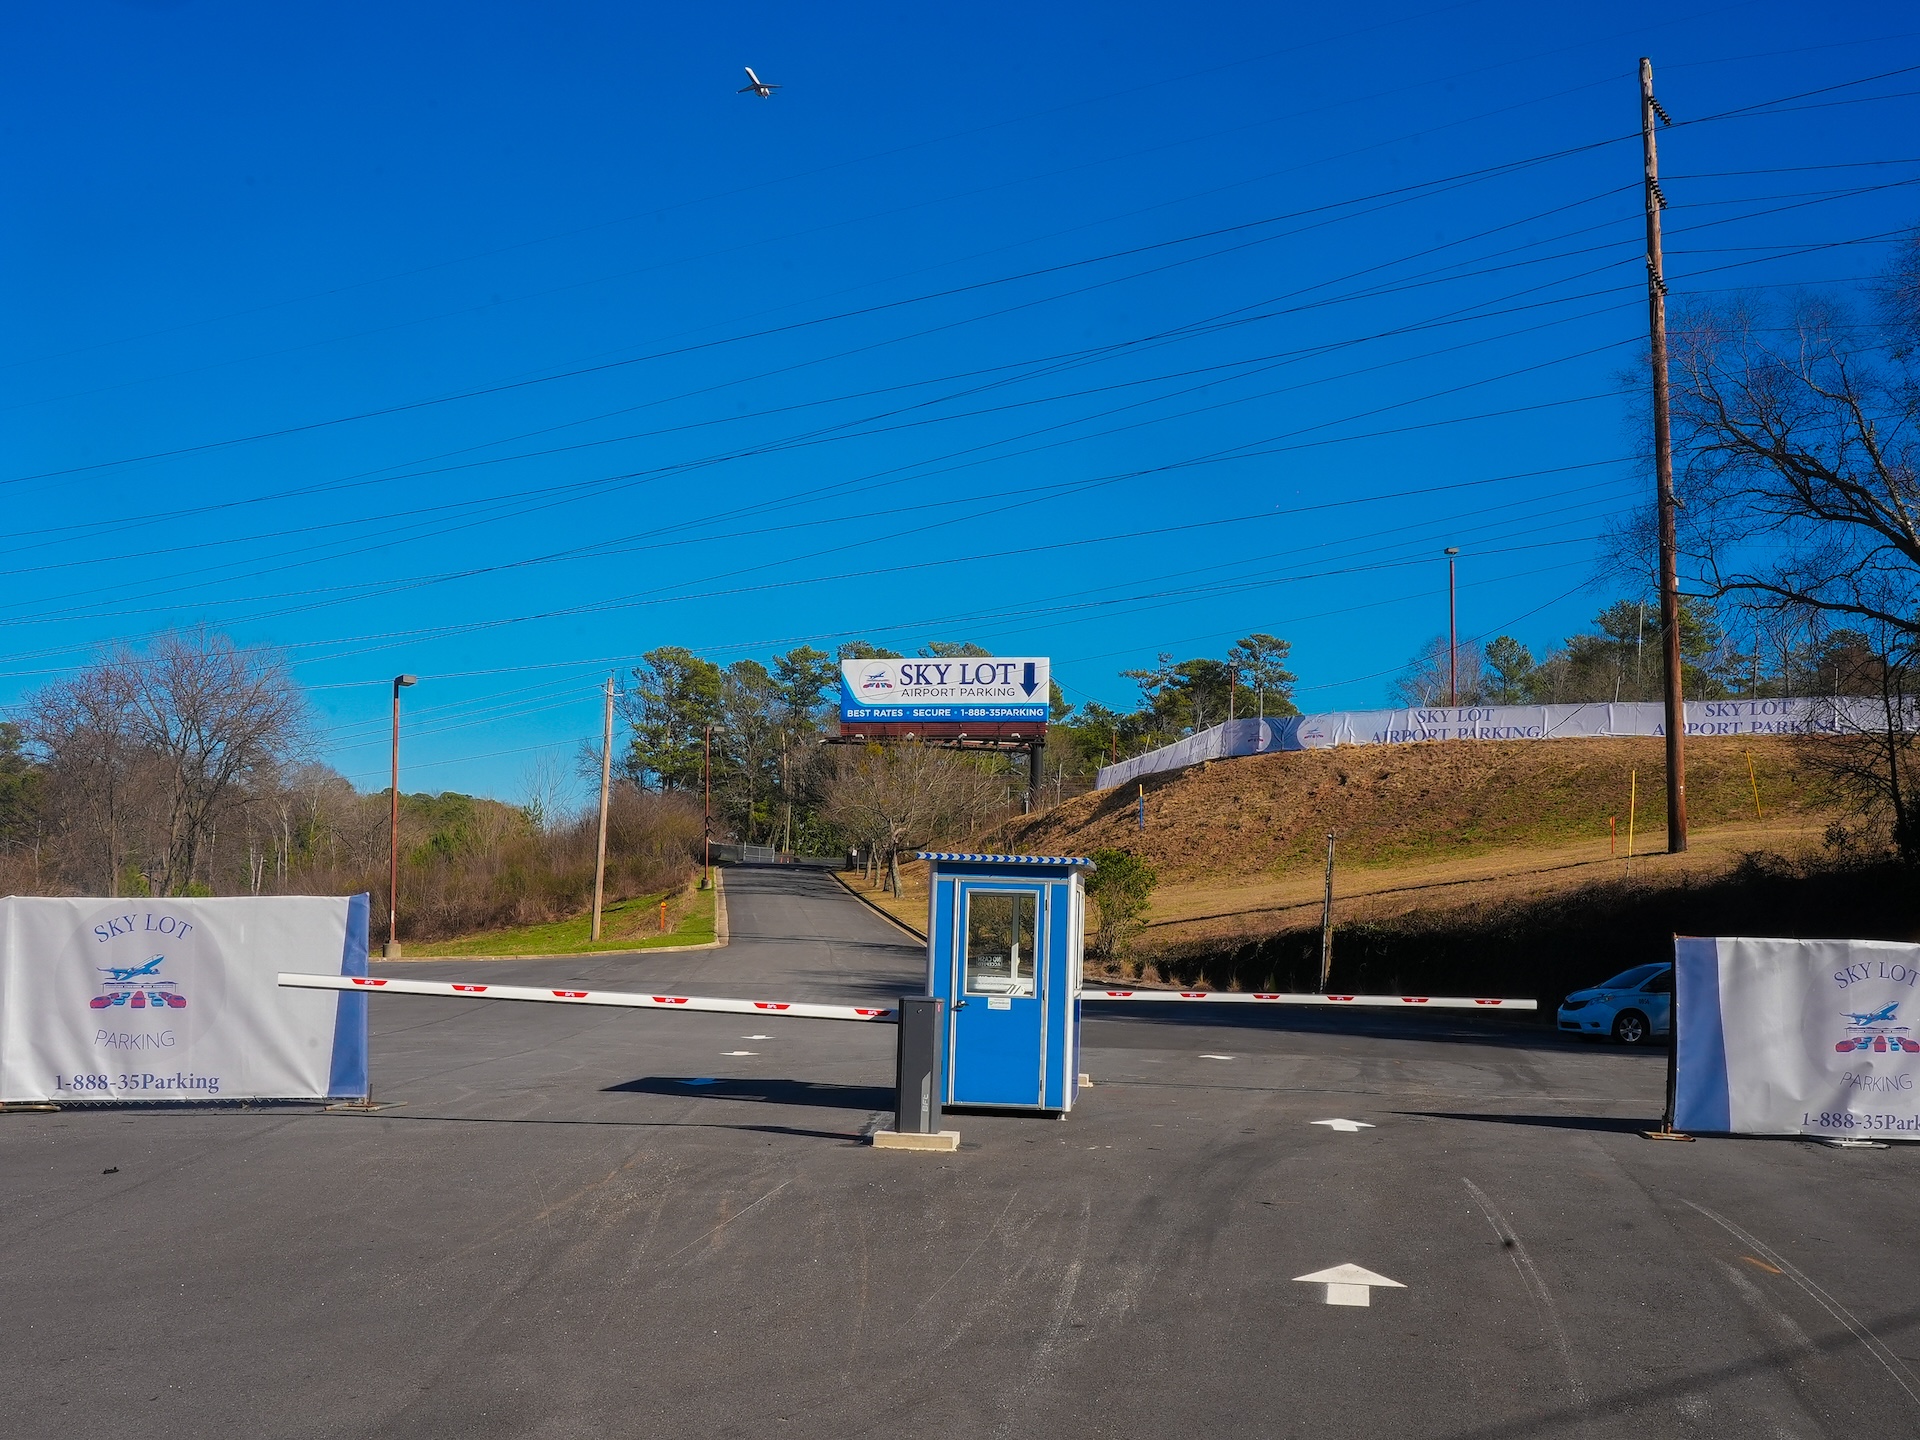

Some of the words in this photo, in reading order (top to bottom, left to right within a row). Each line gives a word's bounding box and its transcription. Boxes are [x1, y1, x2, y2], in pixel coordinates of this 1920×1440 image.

[900, 663, 952, 686] SKY
[959, 663, 1016, 685] LOT
[901, 688, 956, 697] AIRPORT
[960, 688, 1015, 697] PARKING
[847, 709, 872, 717] BEST
[873, 709, 903, 717] RATES
[913, 709, 951, 717] SECURE
[961, 708, 1044, 717] 1-888-35PARKING
[1417, 709, 1451, 724] SKY
[1456, 708, 1494, 723] LOT
[1705, 703, 1742, 717] SKY
[1750, 701, 1792, 716] LOT
[1457, 725, 1541, 740] PARKING
[1652, 722, 1743, 735] APORT
[94, 914, 138, 944] SKY
[145, 913, 193, 942] LOT
[1834, 962, 1872, 989] SKY
[1879, 961, 1920, 988] LOT
[94, 1029, 175, 1051] PARKING
[55, 1072, 220, 1095] 1-888-35Parking
[1840, 1071, 1913, 1092] PARKING
